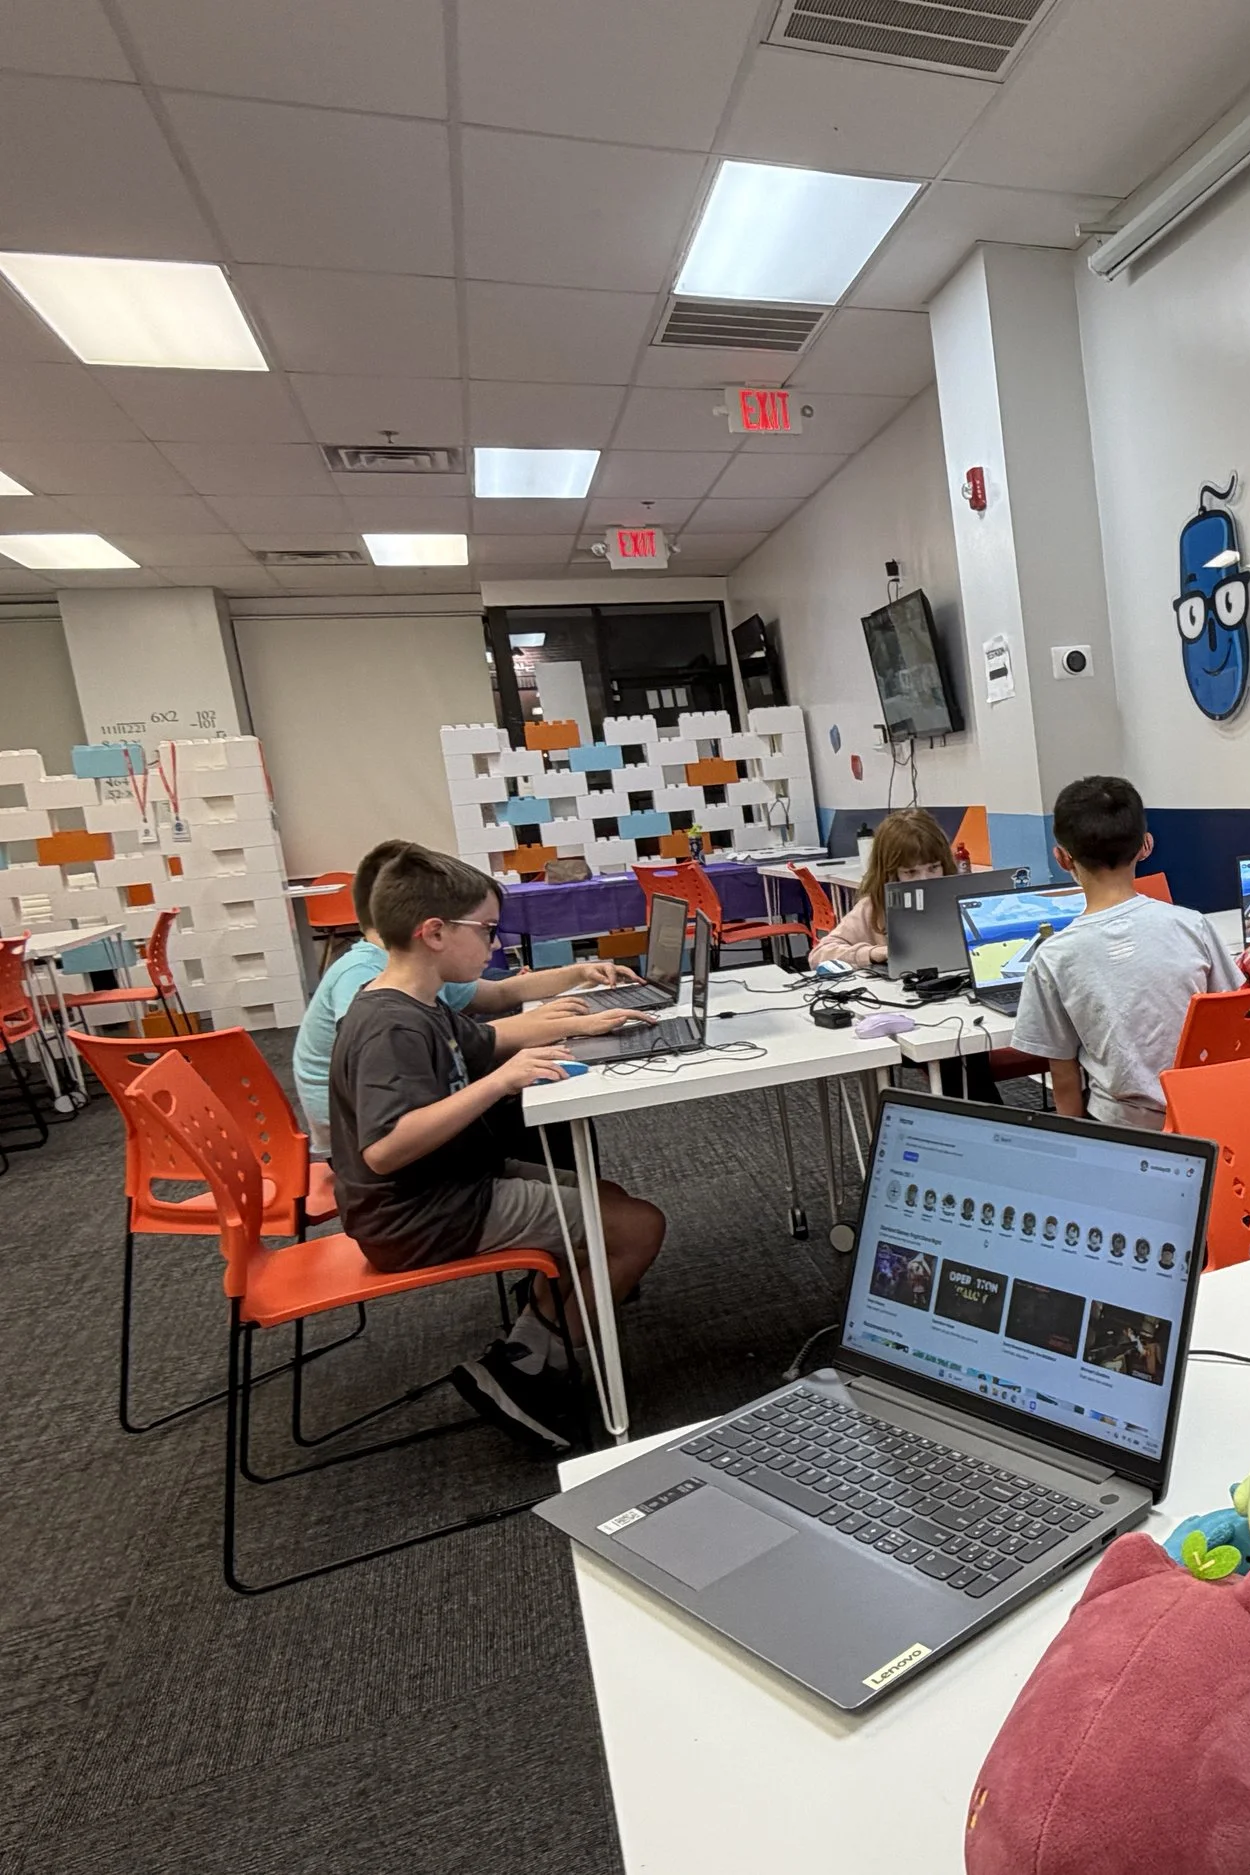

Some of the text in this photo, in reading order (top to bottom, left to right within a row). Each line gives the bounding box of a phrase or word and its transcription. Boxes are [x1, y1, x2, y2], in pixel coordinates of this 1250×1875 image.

[738, 390, 791, 431] EXIT
[616, 529, 656, 558] EXIT
[870, 1649, 923, 1686] Lenovo
